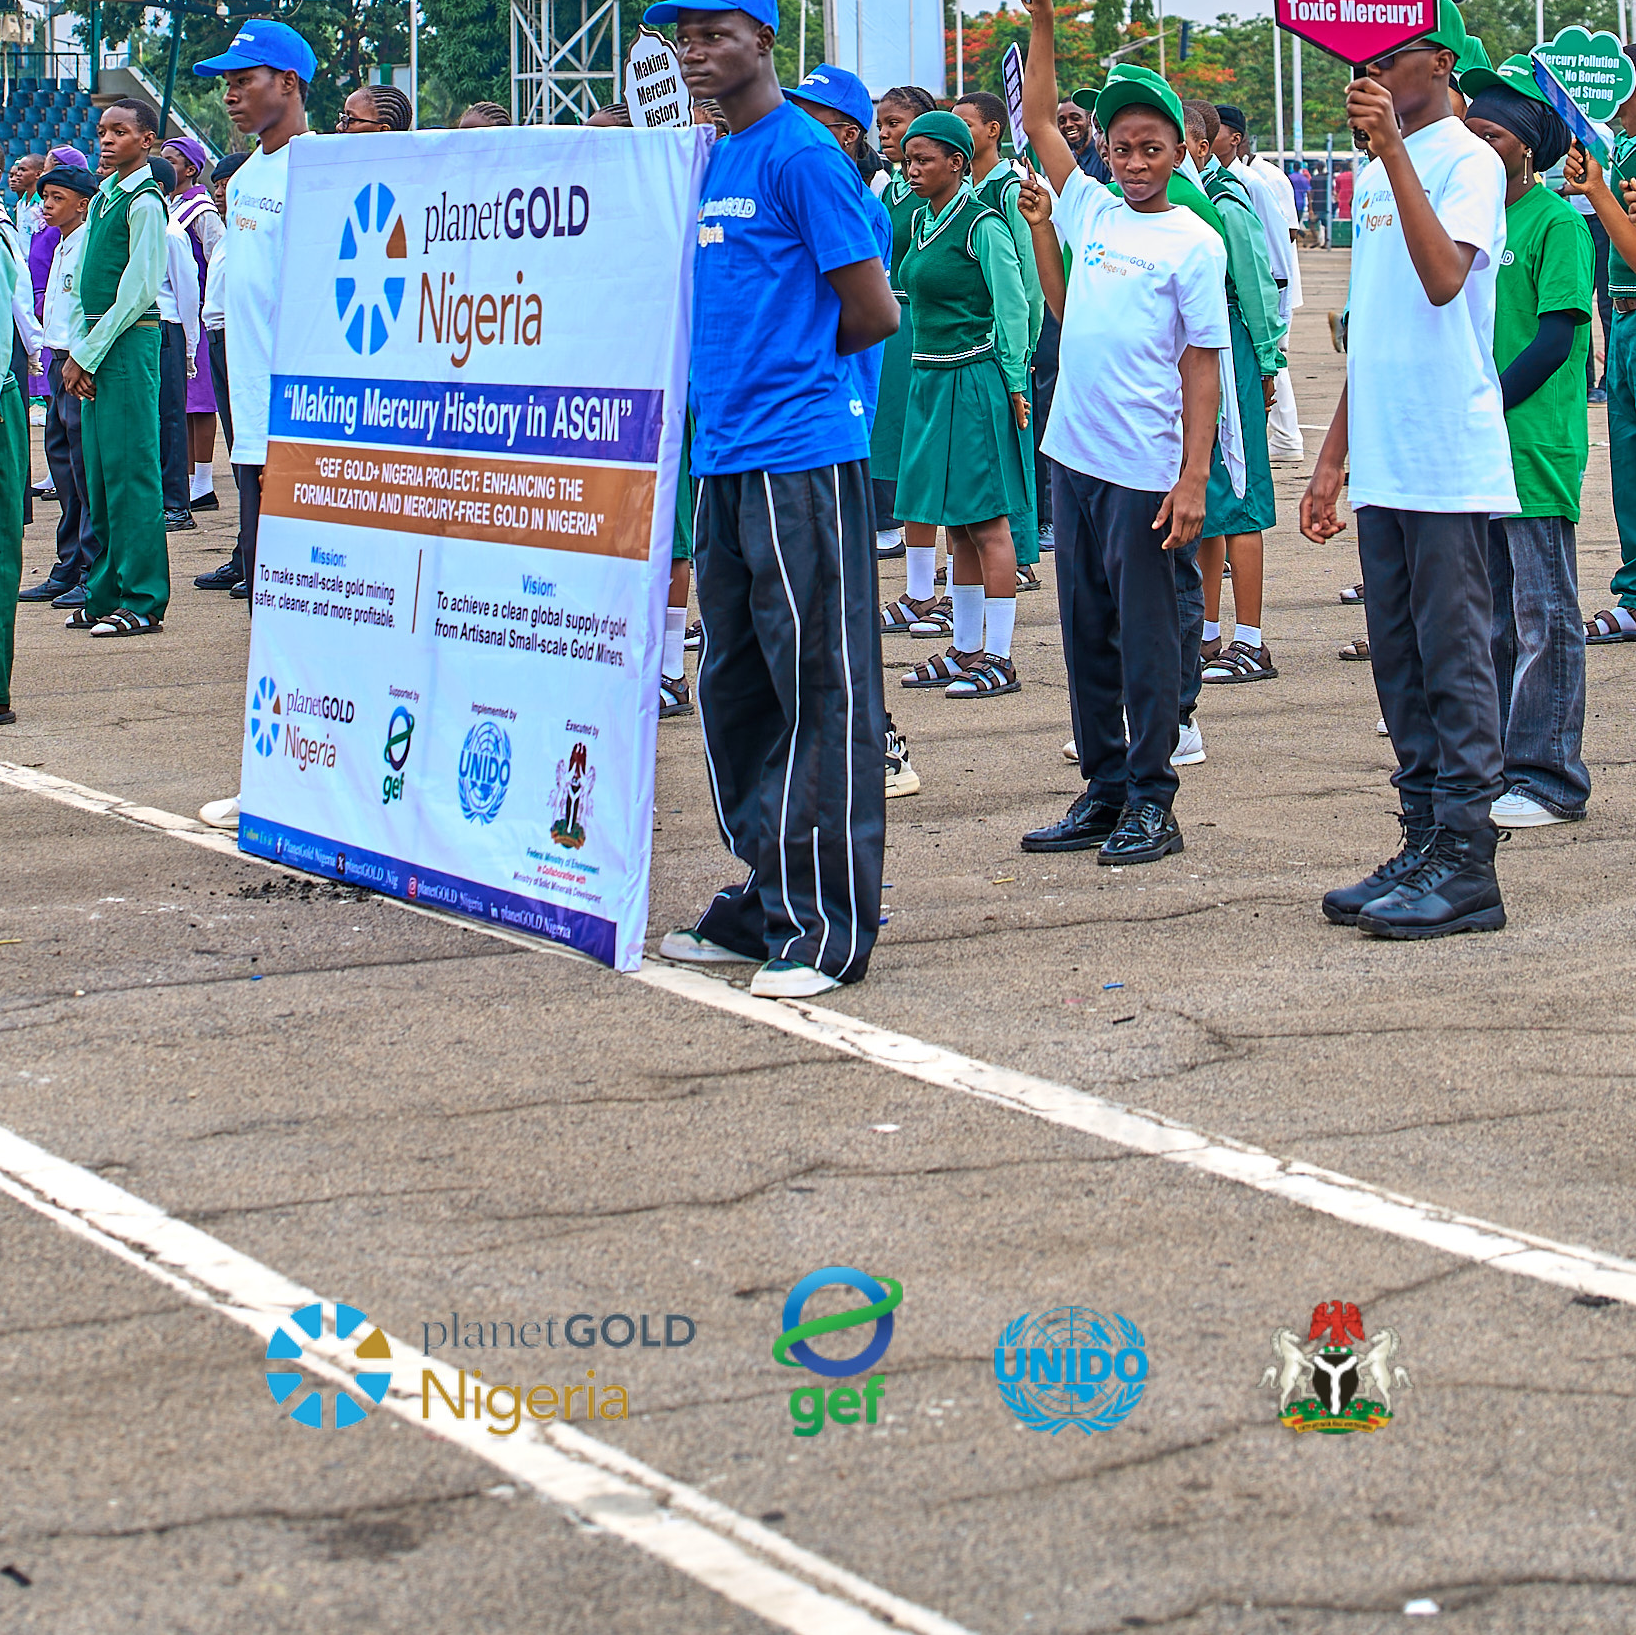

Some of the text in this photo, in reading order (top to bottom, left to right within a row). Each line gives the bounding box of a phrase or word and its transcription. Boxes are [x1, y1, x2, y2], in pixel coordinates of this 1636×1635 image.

[1340, 0, 1423, 26] Mercury!
[633, 52, 669, 81] Making
[1578, 54, 1619, 68] Pollution
[637, 75, 677, 106] Mercury
[1566, 70, 1577, 81] No
[1578, 71, 1615, 85] Borders
[1583, 86, 1613, 102] Strong
[645, 101, 679, 127] History
[422, 185, 589, 254] planetGOLD
[418, 270, 543, 368] Nigeria
[363, 388, 439, 441] Mercury
[443, 392, 521, 446] History
[526, 396, 546, 438] in
[344, 460, 380, 481] GOLD+
[382, 463, 423, 487] NIGERIA
[425, 467, 480, 492] PROJECT:
[483, 472, 555, 499] ENHANCING
[559, 478, 583, 502] THE
[294, 483, 376, 511] FORMALIZATION
[379, 493, 401, 514] AND
[403, 494, 491, 524] MERCURY-FREE
[494, 504, 528, 529] GOLD
[531, 508, 544, 530] IN
[311, 546, 347, 567] Mission:
[260, 564, 394, 605] To make small-scale gold mining
[522, 574, 557, 597] Vision:
[255, 590, 395, 628] safer, cleaner, and more profitable.
[437, 591, 627, 641] To achieve a clean global supply of gold
[435, 618, 625, 666] from Artisanal Small-scale Gold Miners.
[287, 688, 354, 723] planetGOLD
[389, 685, 420, 704] Supported by
[471, 701, 517, 722] Implemented by
[565, 719, 599, 739] Executed by
[284, 723, 336, 771] Nigeria
[459, 750, 511, 787] UNIDO
[383, 772, 404, 804] gef
[513, 871, 534, 886] Ministry
